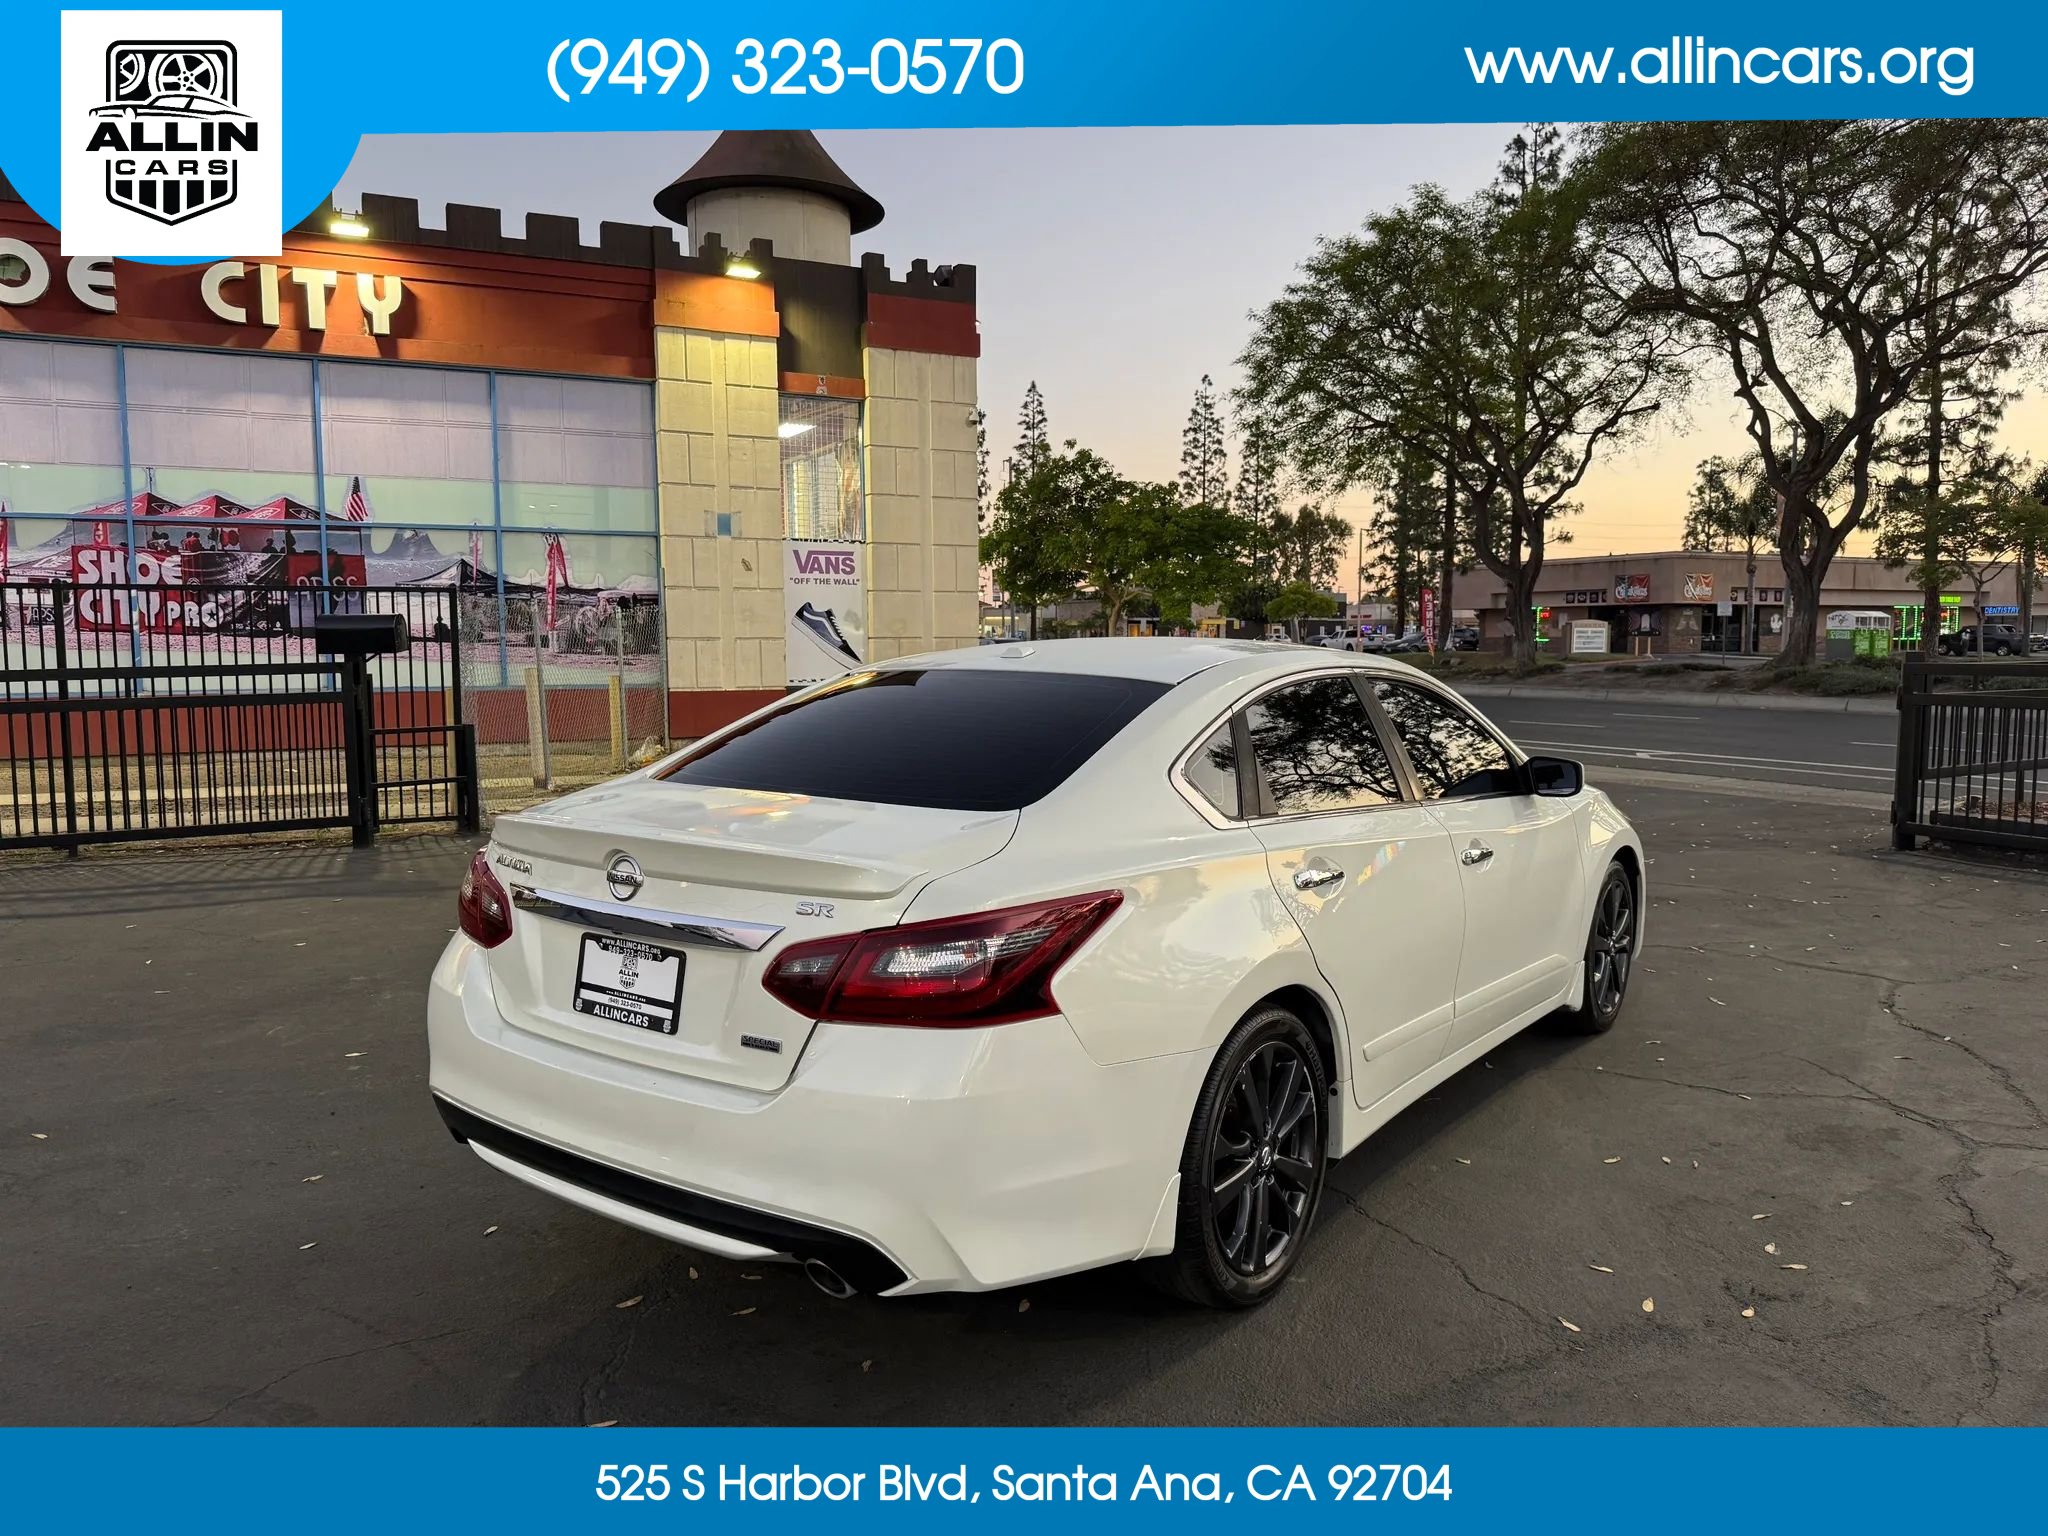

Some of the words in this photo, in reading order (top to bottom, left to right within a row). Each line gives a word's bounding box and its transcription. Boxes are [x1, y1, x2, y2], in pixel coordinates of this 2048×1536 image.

[200, 260, 403, 335] CITY
[77, 549, 183, 585] SHOE
[792, 549, 856, 575] VANS
[813, 577, 831, 585] THE
[79, 588, 161, 627] CITY
[167, 600, 224, 628] PRO
[1984, 606, 2020, 615] DENTISTRY
[609, 872, 638, 885] NISSAN
[795, 901, 835, 918] SR
[619, 968, 639, 978] ALLIN
[593, 1004, 649, 1027] ALLINCARS
[743, 1036, 778, 1048] SPECIAL
